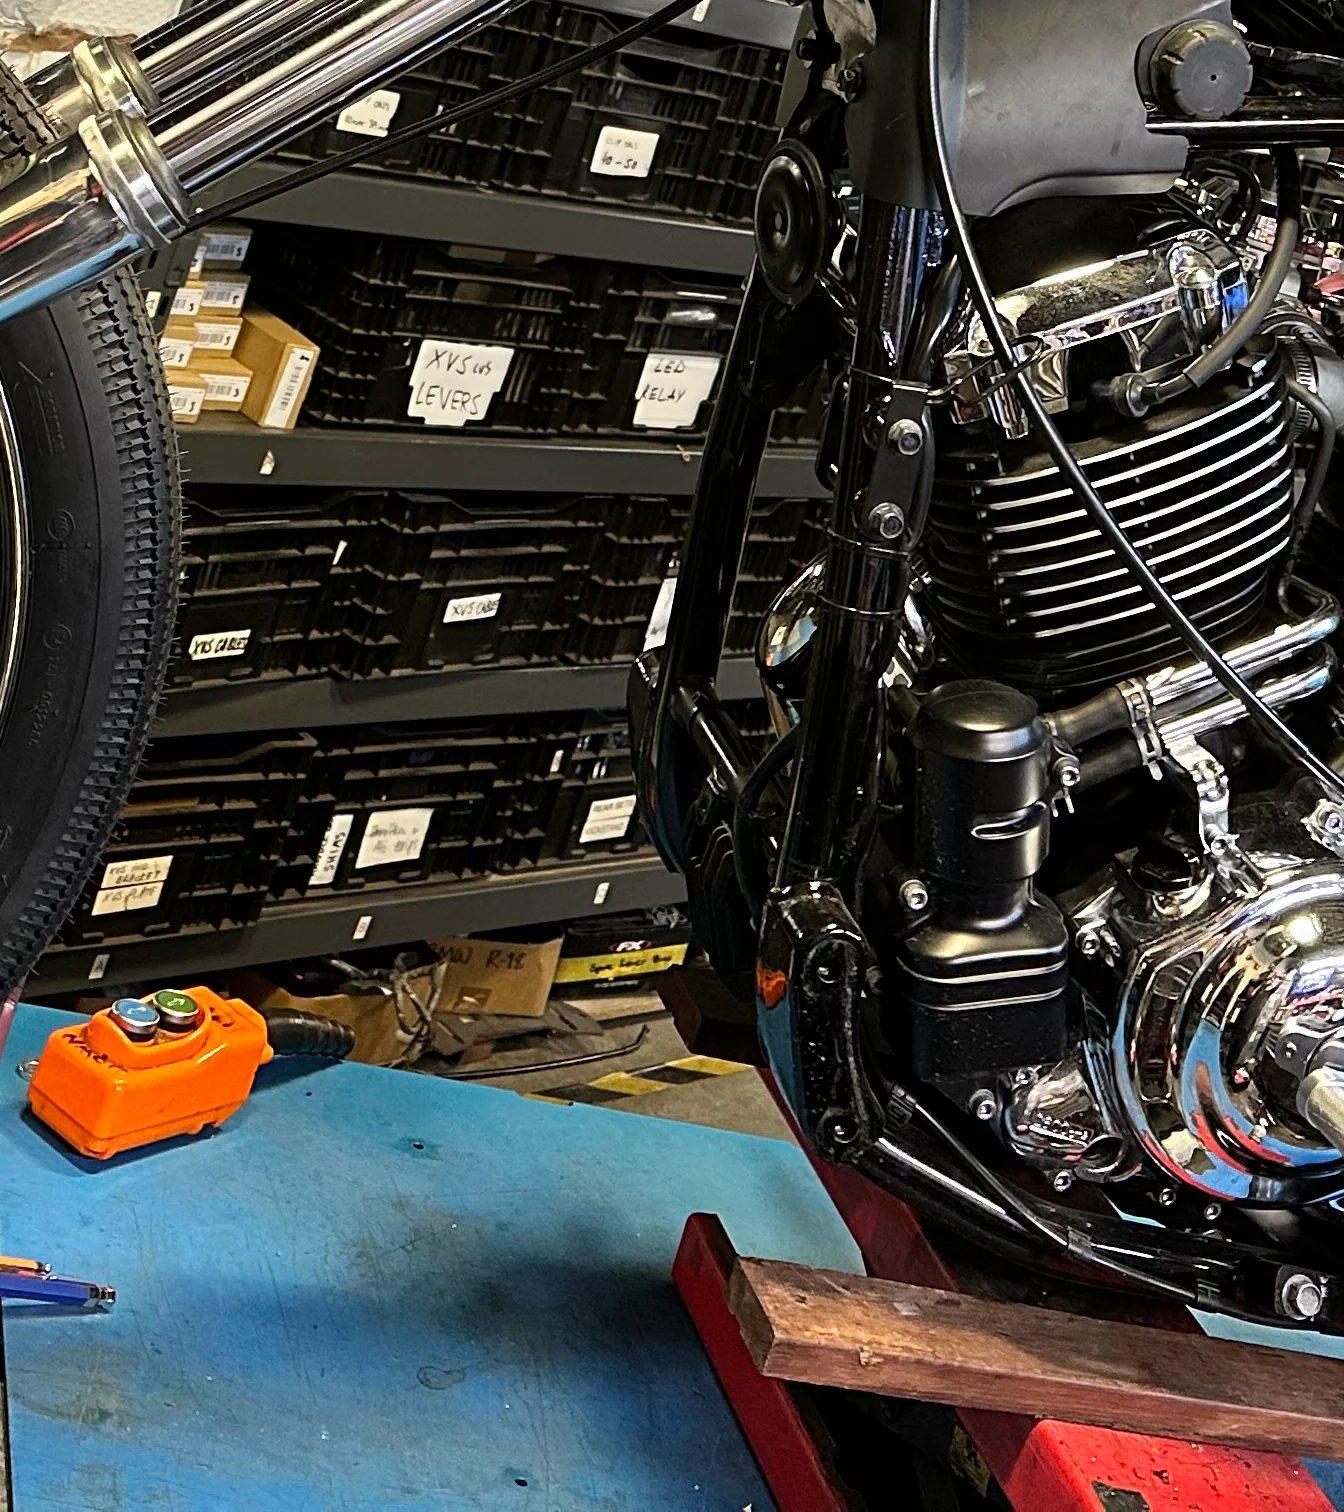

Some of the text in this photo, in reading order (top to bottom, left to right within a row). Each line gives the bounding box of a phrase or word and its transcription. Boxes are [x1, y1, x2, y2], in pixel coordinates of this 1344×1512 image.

[425, 348, 473, 376] XVS
[653, 357, 687, 374] LED
[414, 381, 482, 416] LEVERS
[638, 383, 687, 404] RELAY
